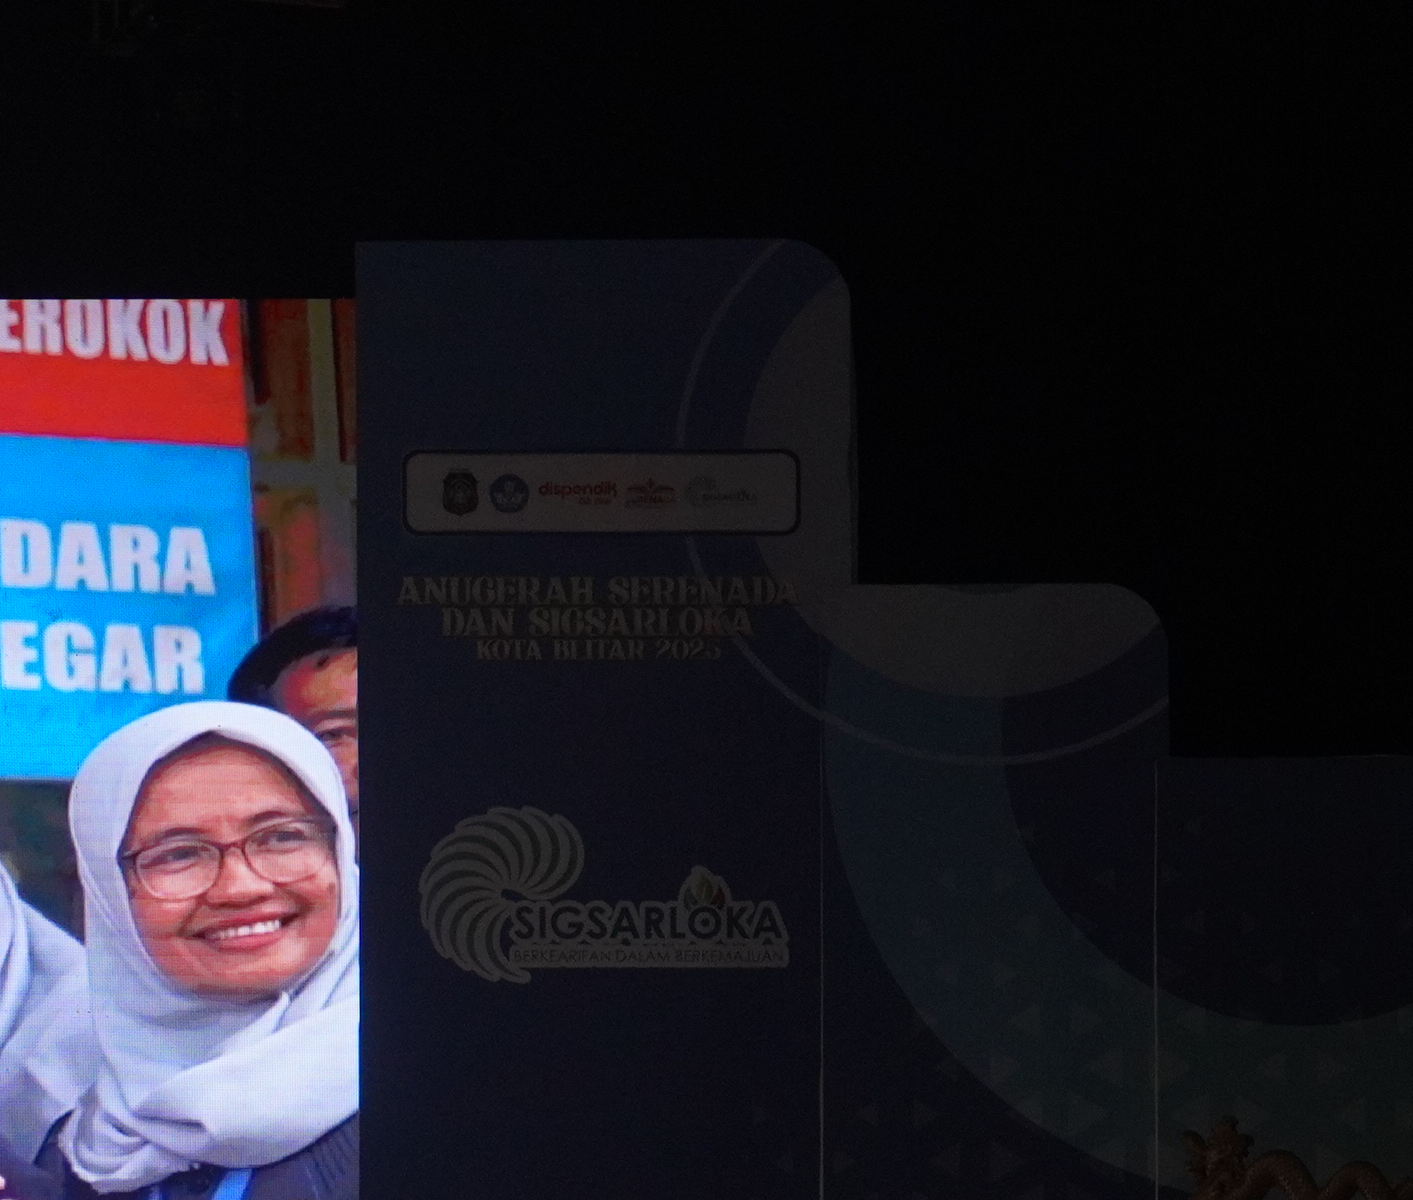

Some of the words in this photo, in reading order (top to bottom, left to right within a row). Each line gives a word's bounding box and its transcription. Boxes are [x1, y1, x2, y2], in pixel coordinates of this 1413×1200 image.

[398, 576, 595, 605] ANUGERAH
[609, 575, 800, 604] SERENADA
[442, 608, 514, 636] DAN
[528, 607, 753, 636] SIGSARLOKA
[477, 640, 543, 661] KOTA
[554, 639, 645, 661] BLITAR
[655, 638, 722, 660] 2025
[514, 905, 783, 940] SIGSARLOKA
[514, 949, 611, 963] BERKEARIFAN
[616, 949, 670, 963] DALAM
[675, 949, 784, 963] BERKEMAJUAN
